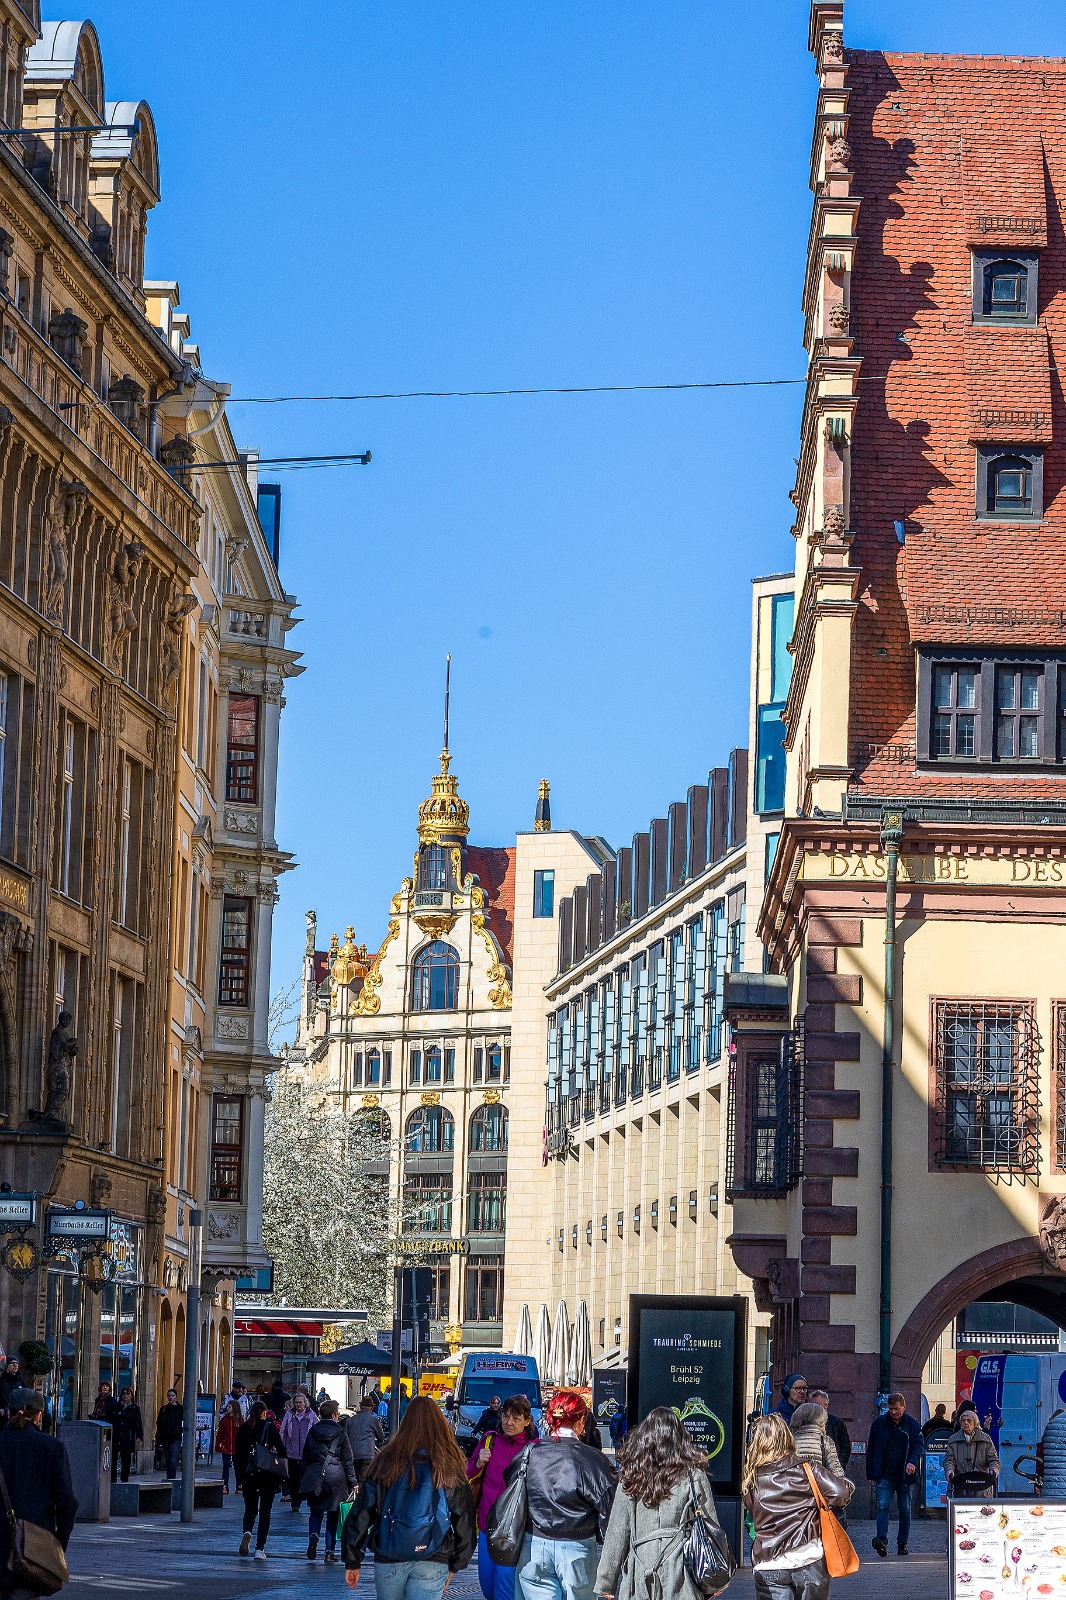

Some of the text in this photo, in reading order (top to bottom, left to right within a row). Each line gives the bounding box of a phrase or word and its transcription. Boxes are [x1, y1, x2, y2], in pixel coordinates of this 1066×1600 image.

[828, 855, 1063, 882] DASELBE DES
[53, 1220, 104, 1232] Auerbachs Keller
[653, 1338, 722, 1348] TRAURING SCHMIEDE
[349, 1364, 374, 1375] Tchibo
[670, 1365, 704, 1374] Brühl 52
[672, 1374, 701, 1385] Leipzig
